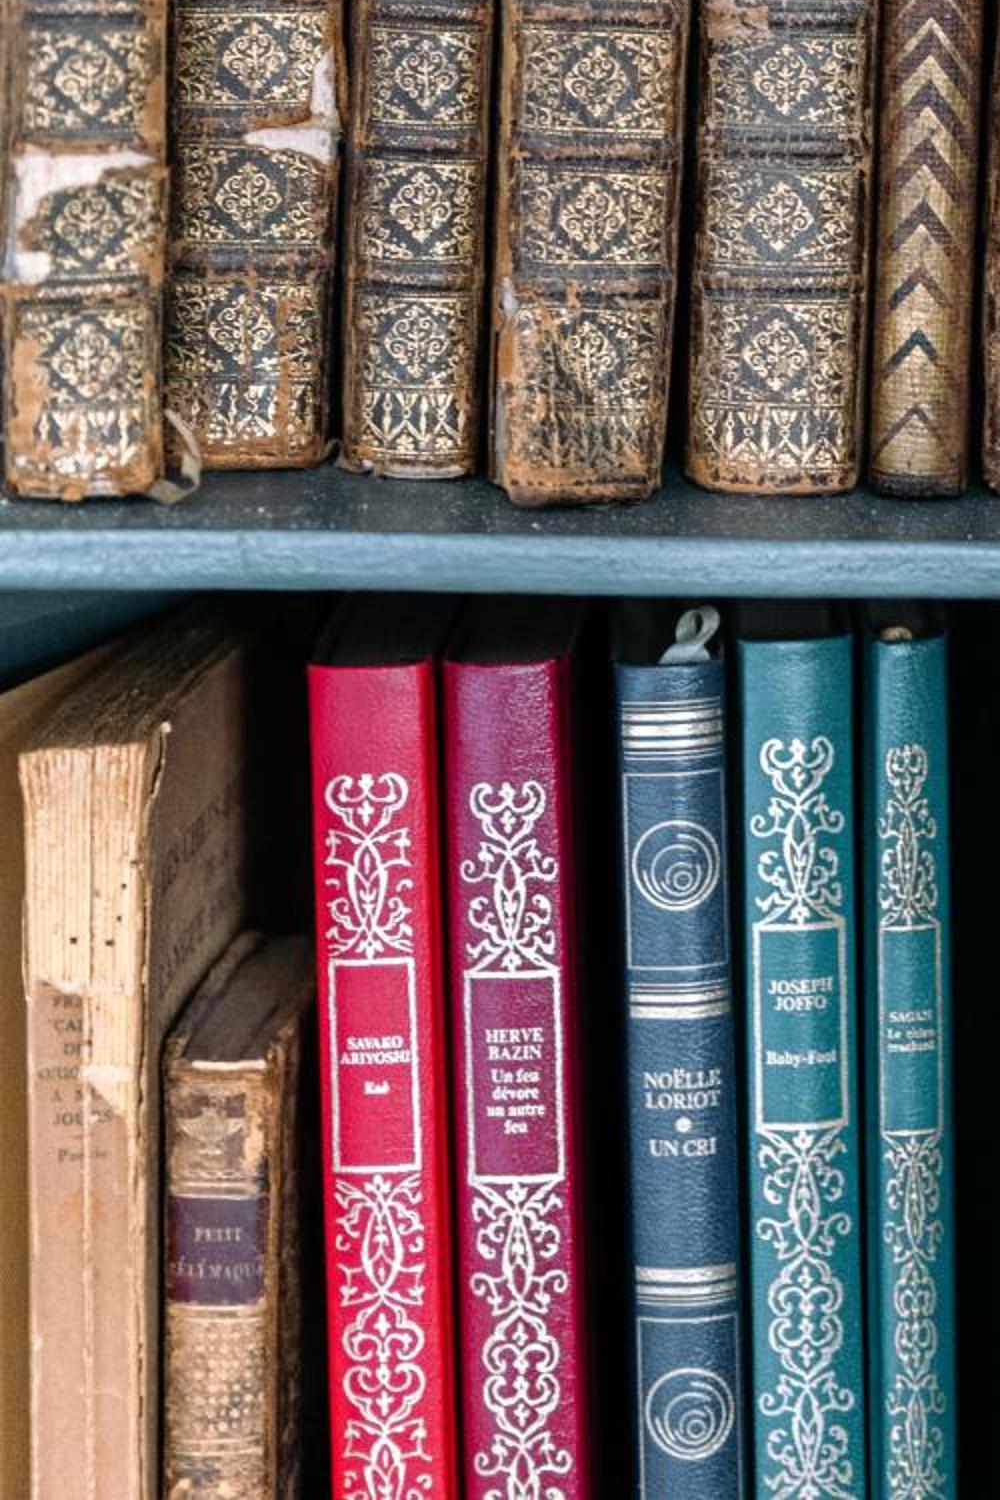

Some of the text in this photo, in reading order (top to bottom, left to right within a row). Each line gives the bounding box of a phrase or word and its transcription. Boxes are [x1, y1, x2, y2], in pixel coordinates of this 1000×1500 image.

[768, 976, 833, 996] JOSEPH
[773, 995, 827, 1011] JOFFO
[339, 1049, 412, 1065] ARIYOSHI
[488, 1045, 543, 1061] BAZIN
[491, 1068, 540, 1083] Un feu
[643, 1067, 722, 1089] NOËLLE
[491, 1085, 540, 1101] dévore
[645, 1090, 722, 1109] LORIOT
[486, 1103, 546, 1118] un autre
[503, 1120, 529, 1135] feu
[650, 1137, 717, 1157] UN CRI
